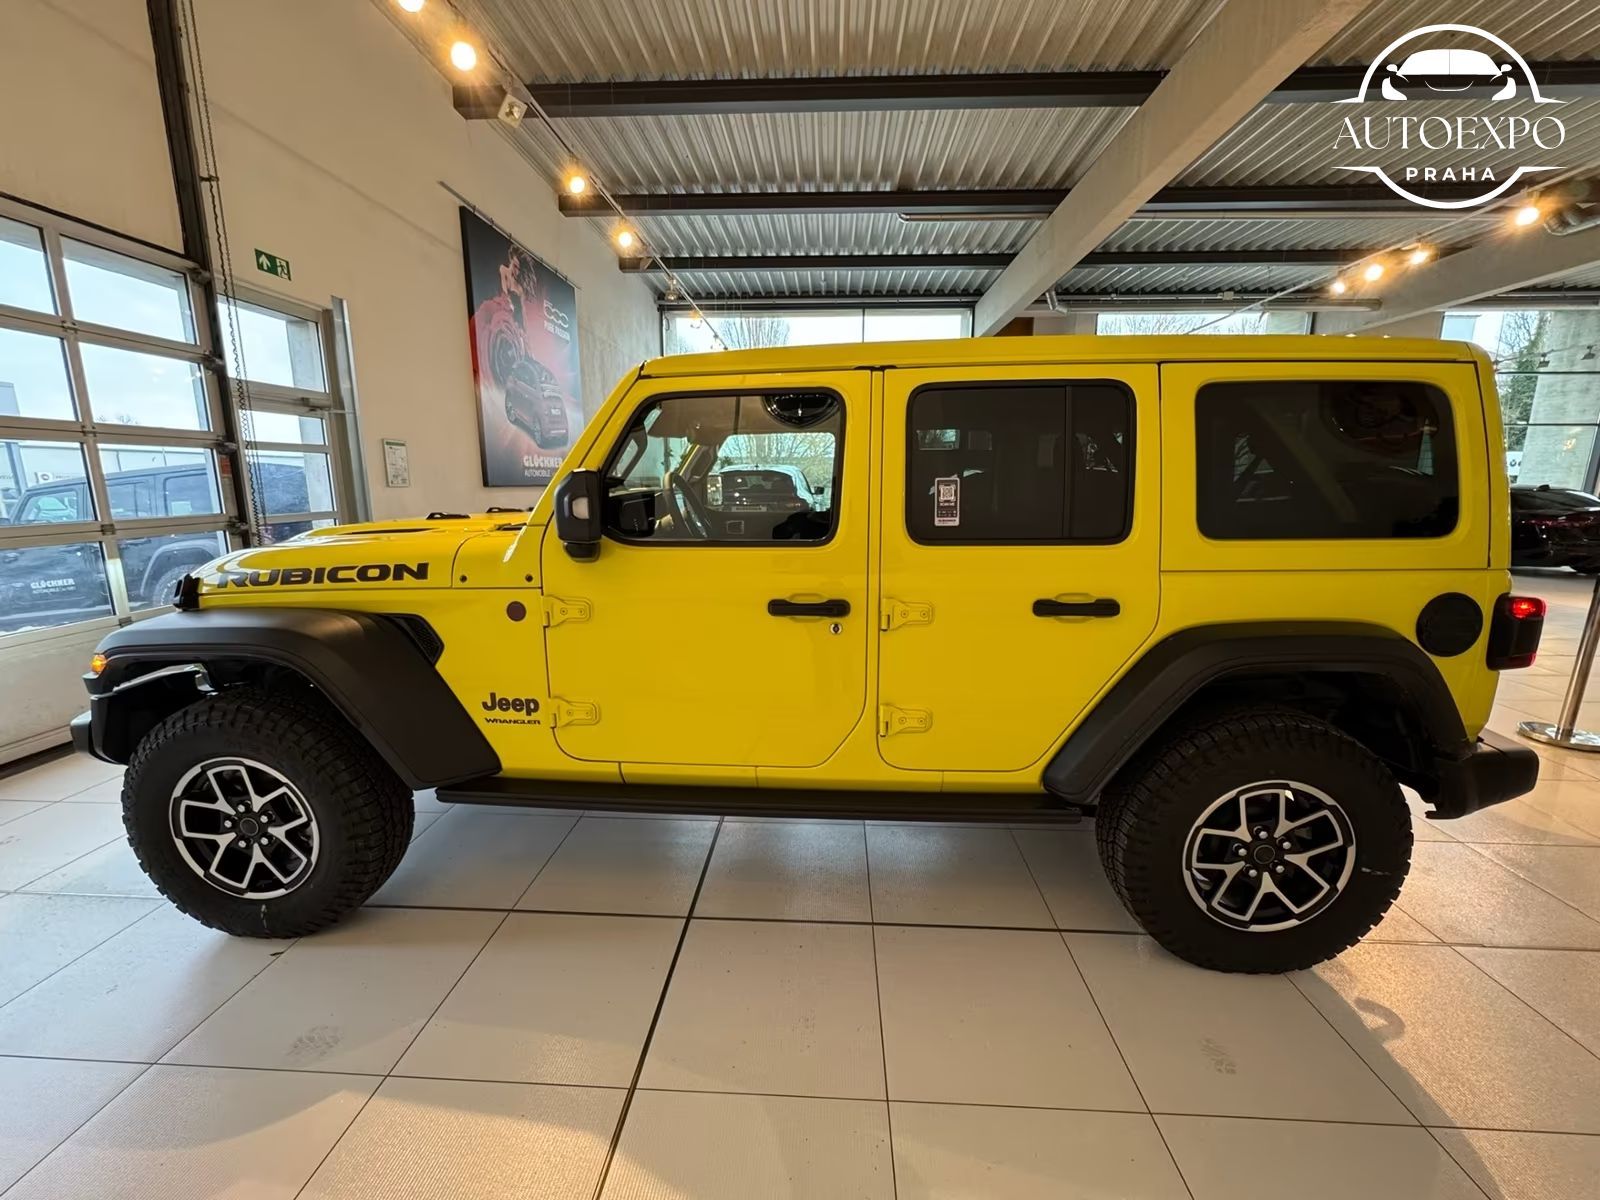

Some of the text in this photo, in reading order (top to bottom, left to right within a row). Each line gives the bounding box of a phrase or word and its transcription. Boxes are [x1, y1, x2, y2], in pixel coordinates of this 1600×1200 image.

[216, 562, 429, 589] RUBICON
[481, 692, 540, 716] Jeep
[484, 717, 541, 725] WRANGLER
